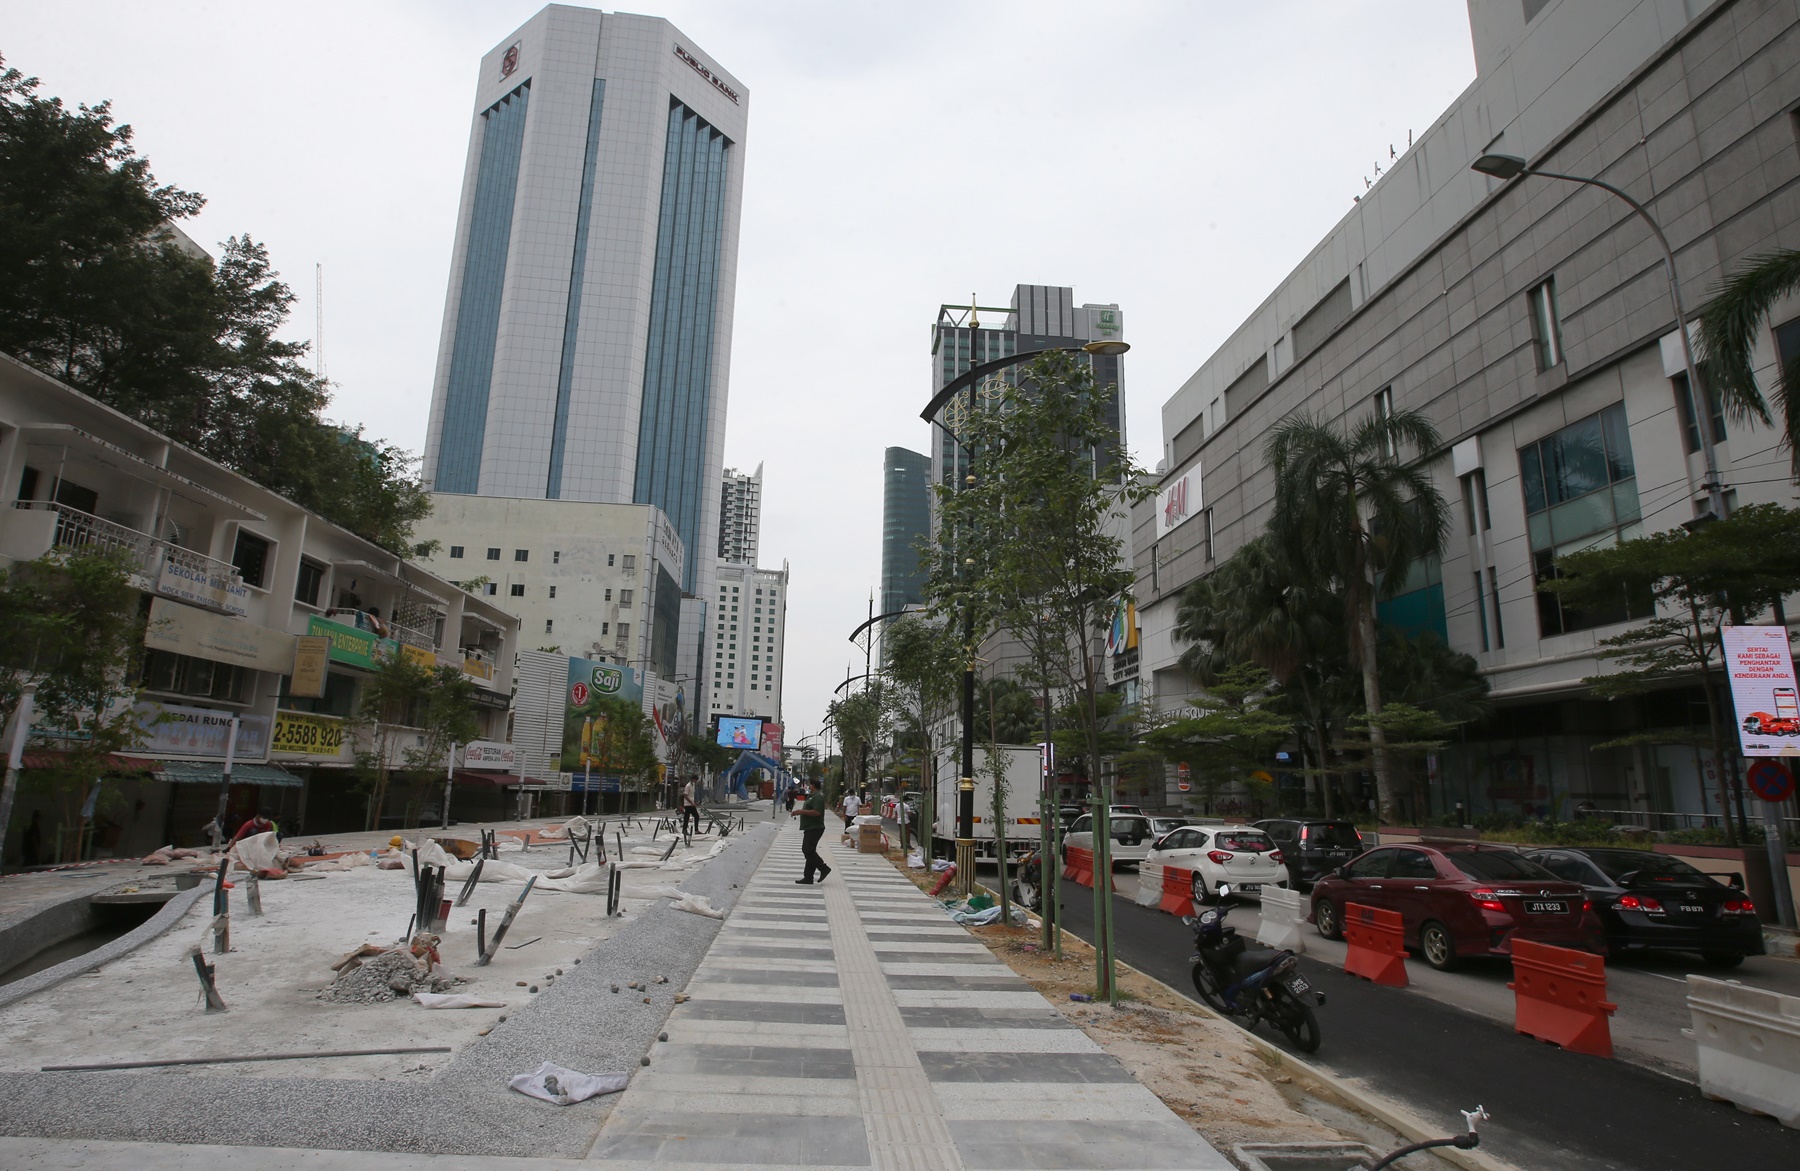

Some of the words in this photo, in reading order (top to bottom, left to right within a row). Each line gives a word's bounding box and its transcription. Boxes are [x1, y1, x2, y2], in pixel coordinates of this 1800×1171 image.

[676, 46, 710, 79] PUBLIC
[711, 75, 738, 103] BANK
[168, 564, 207, 585] SEKOLAH
[209, 578, 248, 598] MENJAHIT
[162, 584, 179, 596] HOCK
[181, 590, 195, 600] SIEW
[225, 603, 246, 615] SCHOOL
[338, 633, 370, 657] ENTERPRISE
[594, 670, 620, 691] Saji
[203, 716, 245, 728] RUNCT
[483, 746, 502, 755] RESTORAN
[1532, 903, 1545, 911] JTX
[1546, 903, 1561, 911] 1233
[1292, 978, 1304, 988] JMS
[1294, 982, 1309, 994] 2103
